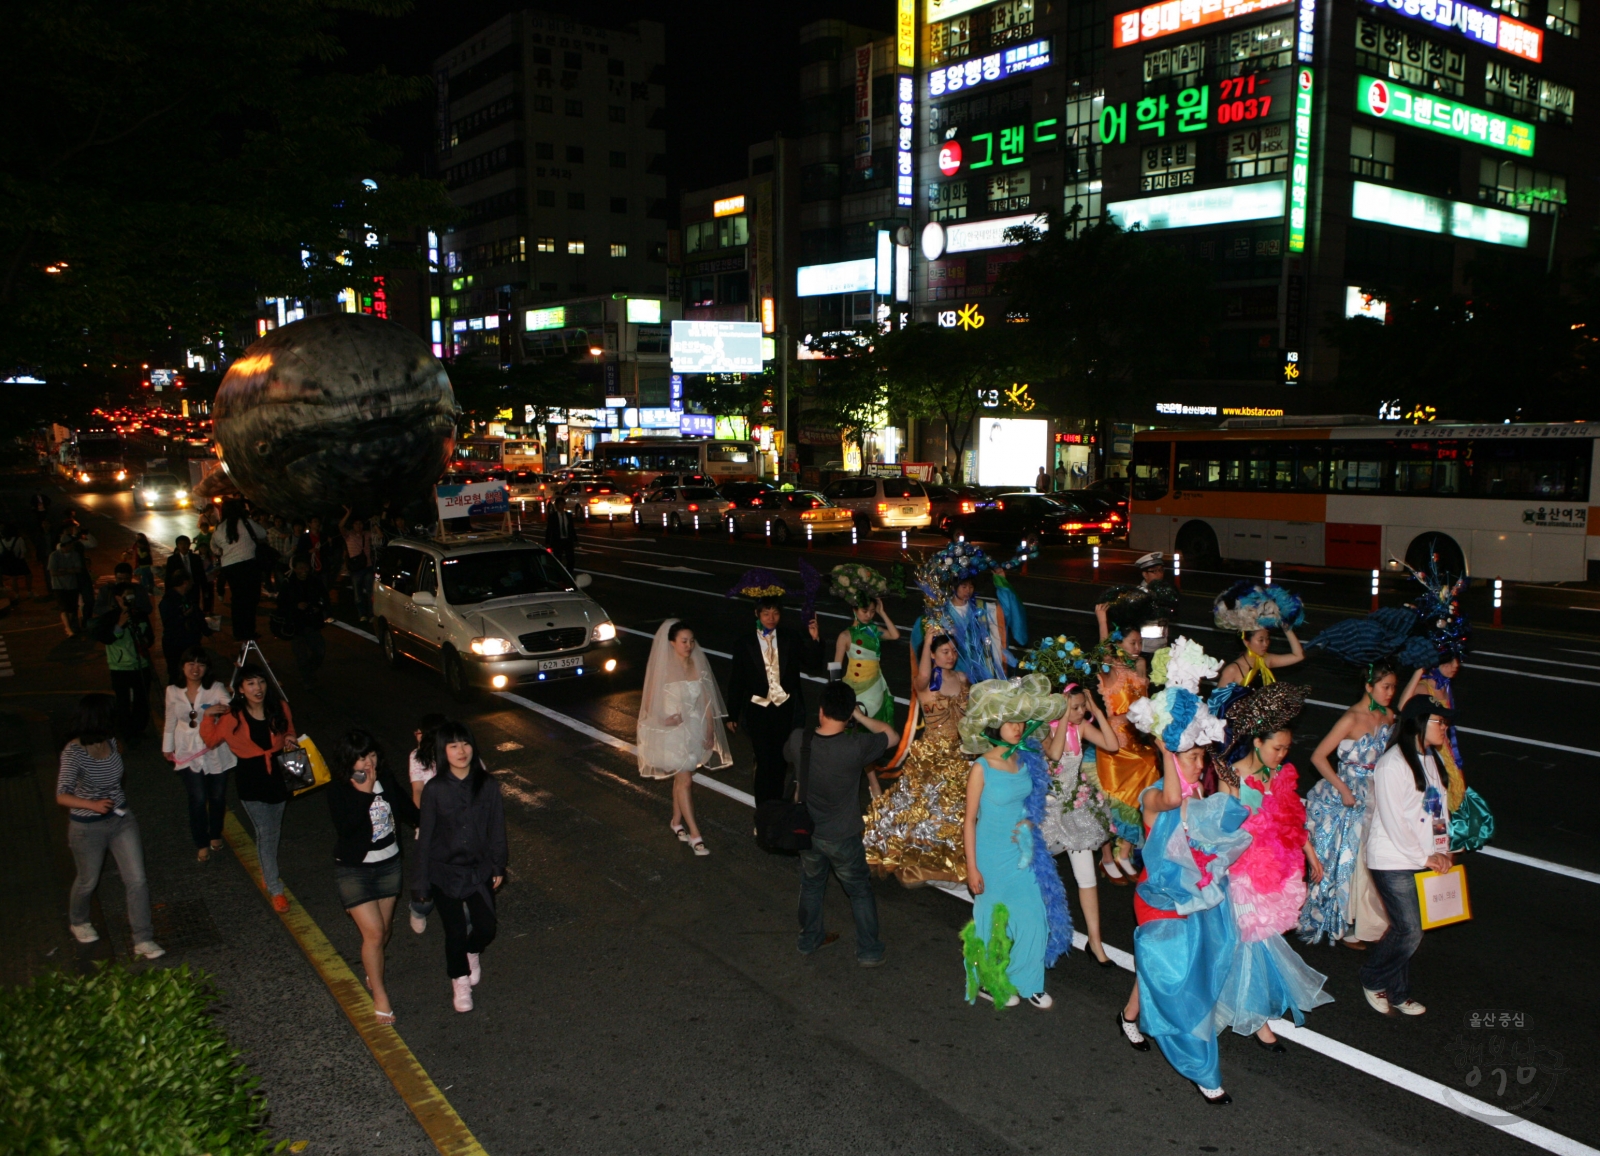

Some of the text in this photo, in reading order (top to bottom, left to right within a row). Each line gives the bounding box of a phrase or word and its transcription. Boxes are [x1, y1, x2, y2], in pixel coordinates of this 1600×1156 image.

[930, 53, 1001, 95] 중앙행정
[1219, 74, 1271, 100] 271-
[1217, 97, 1272, 124] 0037
[1392, 90, 1506, 145] 그랜드어학원
[898, 77, 912, 174] 중앙행정
[969, 85, 1209, 169] 그랜드 어학원
[1264, 140, 1283, 153] HSK
[1147, 143, 1187, 169] 영문법
[1142, 172, 1193, 190] 수시접수
[1255, 238, 1280, 256] 의원
[949, 269, 967, 283] 네일
[938, 311, 956, 328] KB
[1286, 352, 1299, 362] KB
[1223, 407, 1283, 417] www.kbstar.com
[445, 493, 482, 507] 고래모형
[1536, 507, 1586, 521] 울산여객
[561, 657, 580, 668] 3597
[1435, 837, 1446, 845] STAFF
